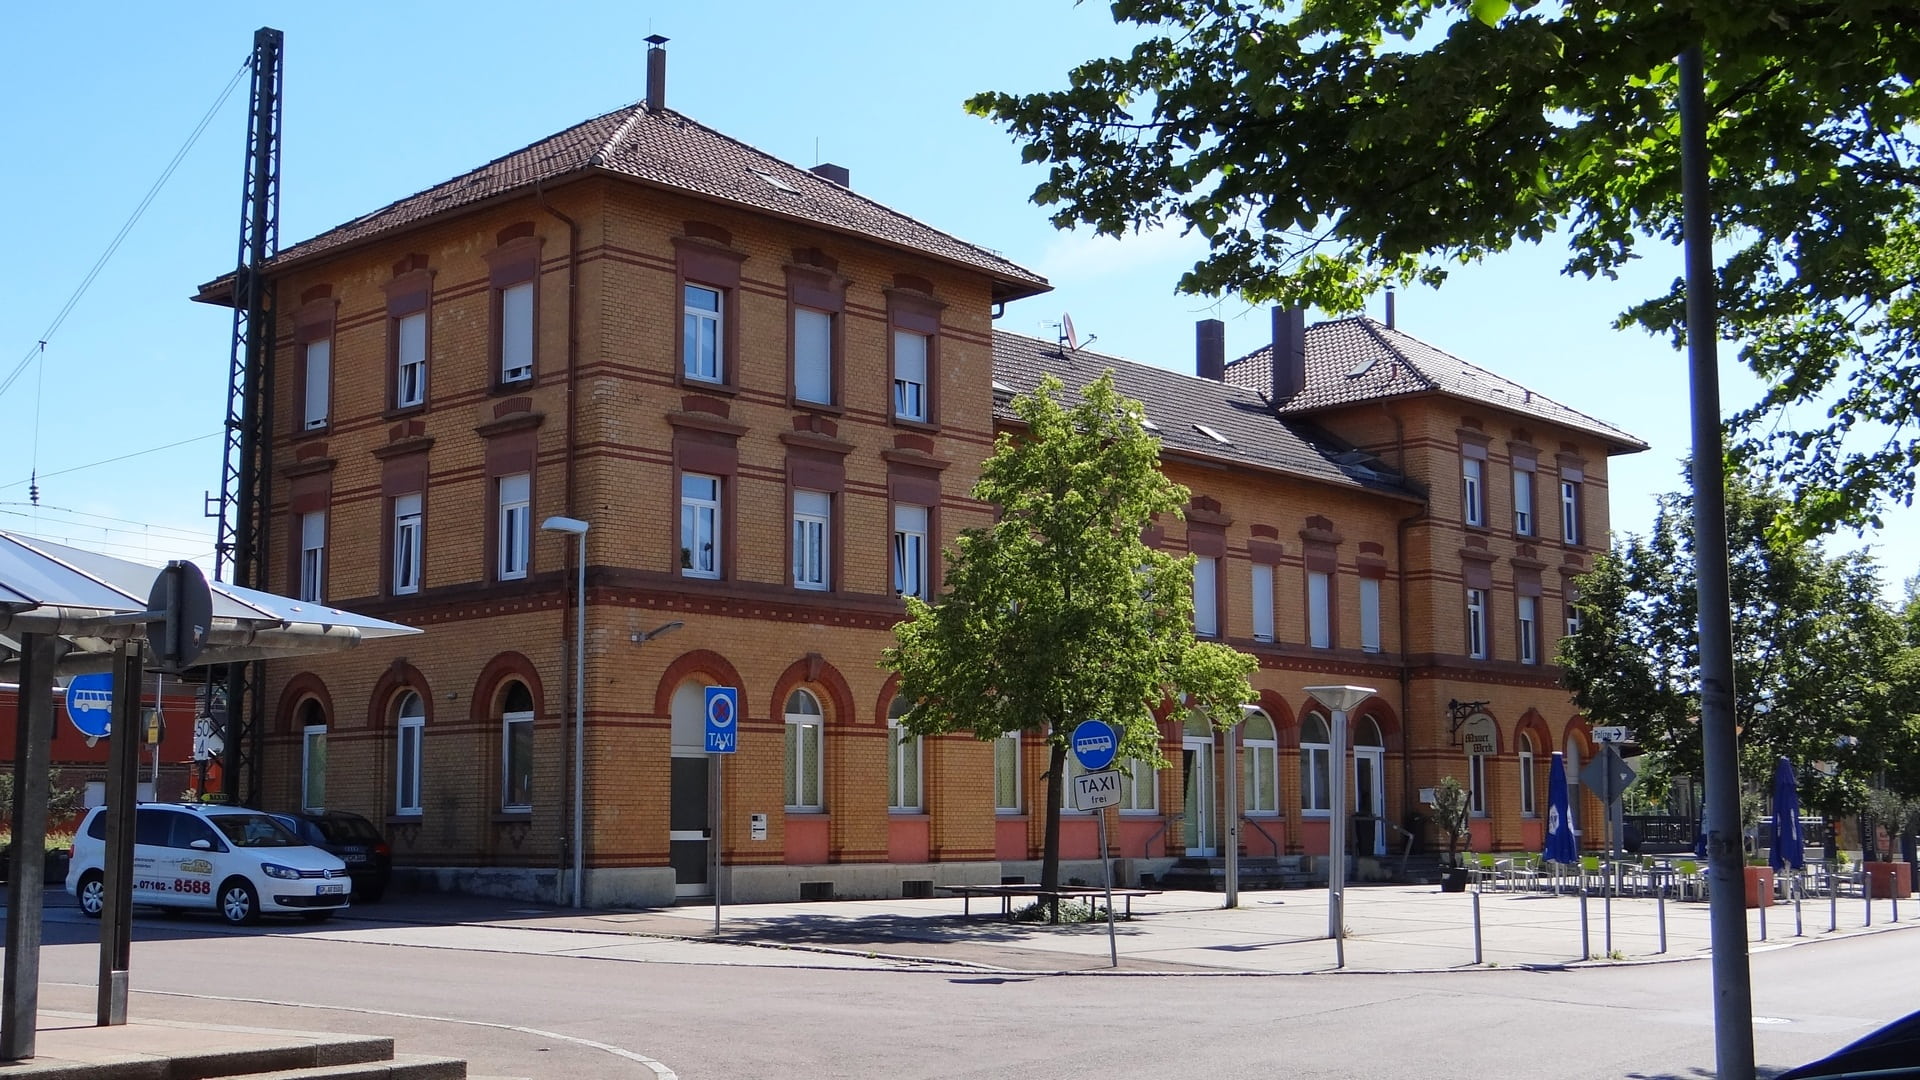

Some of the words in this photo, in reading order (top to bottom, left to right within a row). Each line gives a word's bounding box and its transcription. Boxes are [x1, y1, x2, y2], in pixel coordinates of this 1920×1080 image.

[196, 720, 210, 737] 50
[1594, 730, 1612, 739] Polizei
[708, 732, 733, 747] TAXI
[198, 740, 205, 757] 4
[1079, 776, 1115, 794] TAXI
[1091, 795, 1107, 804] frei
[174, 879, 211, 895] 8588
